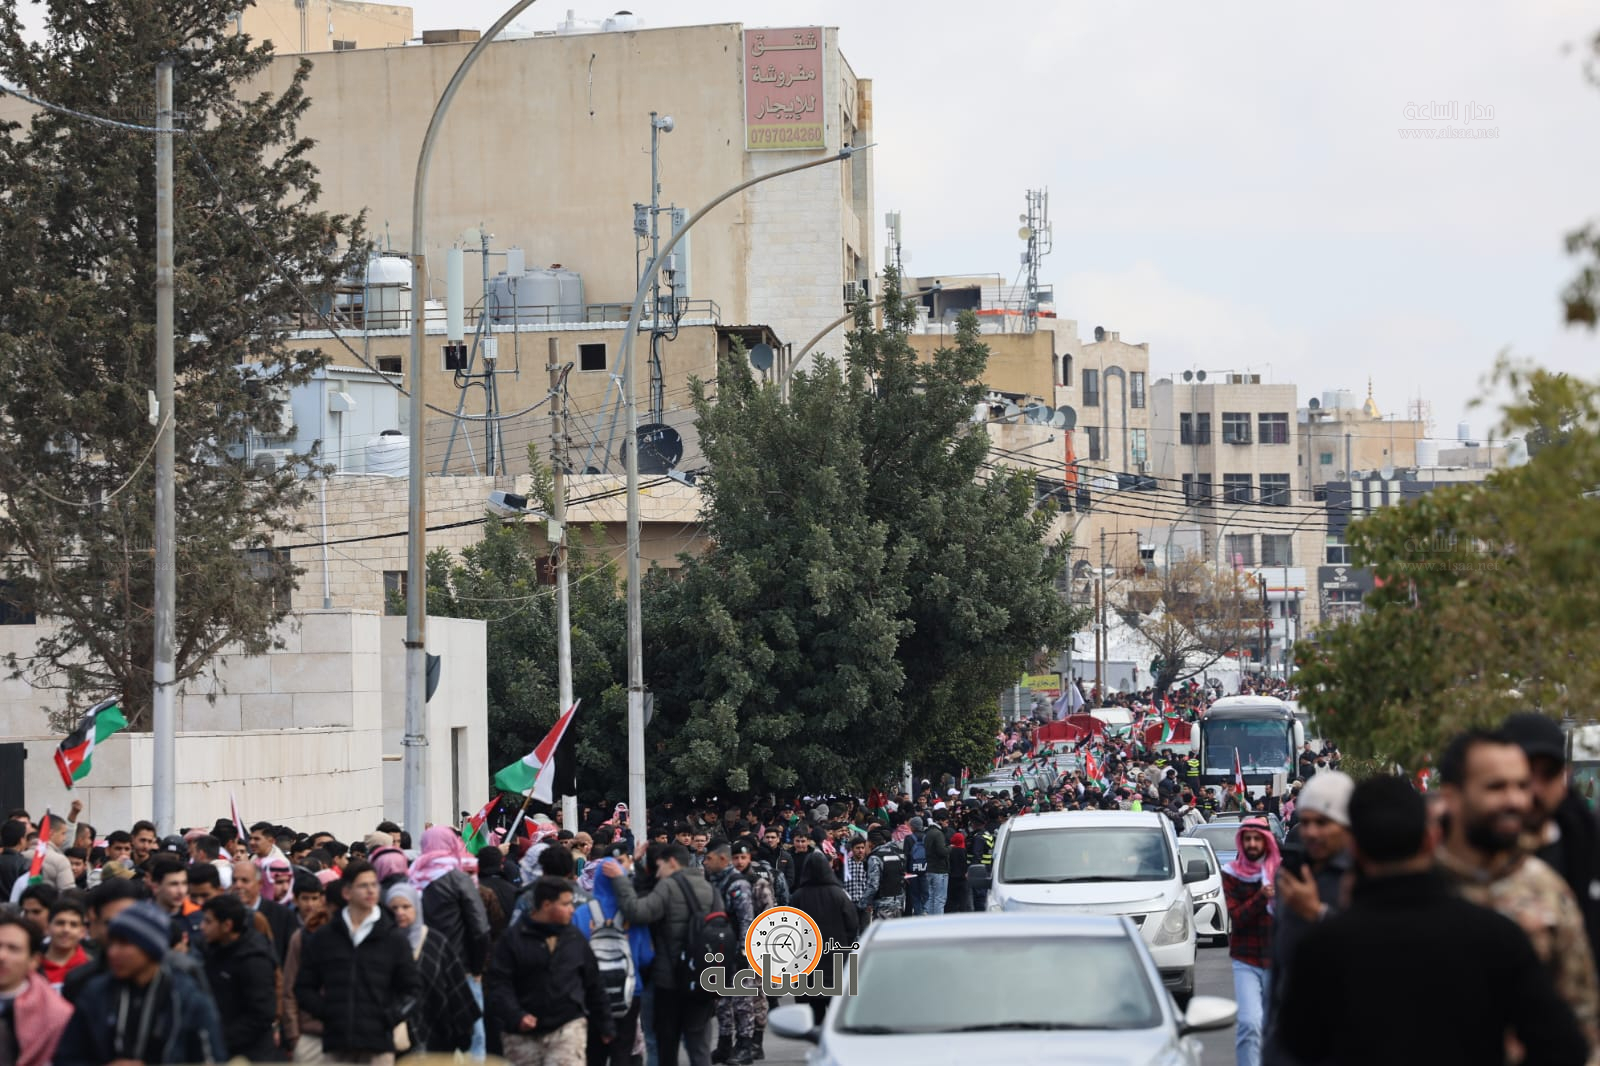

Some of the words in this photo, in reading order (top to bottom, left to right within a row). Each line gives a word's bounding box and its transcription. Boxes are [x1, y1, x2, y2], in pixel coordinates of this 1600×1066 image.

[750, 32, 818, 57] شقق
[752, 64, 816, 87] مفروشة
[754, 95, 817, 120] للإيجار
